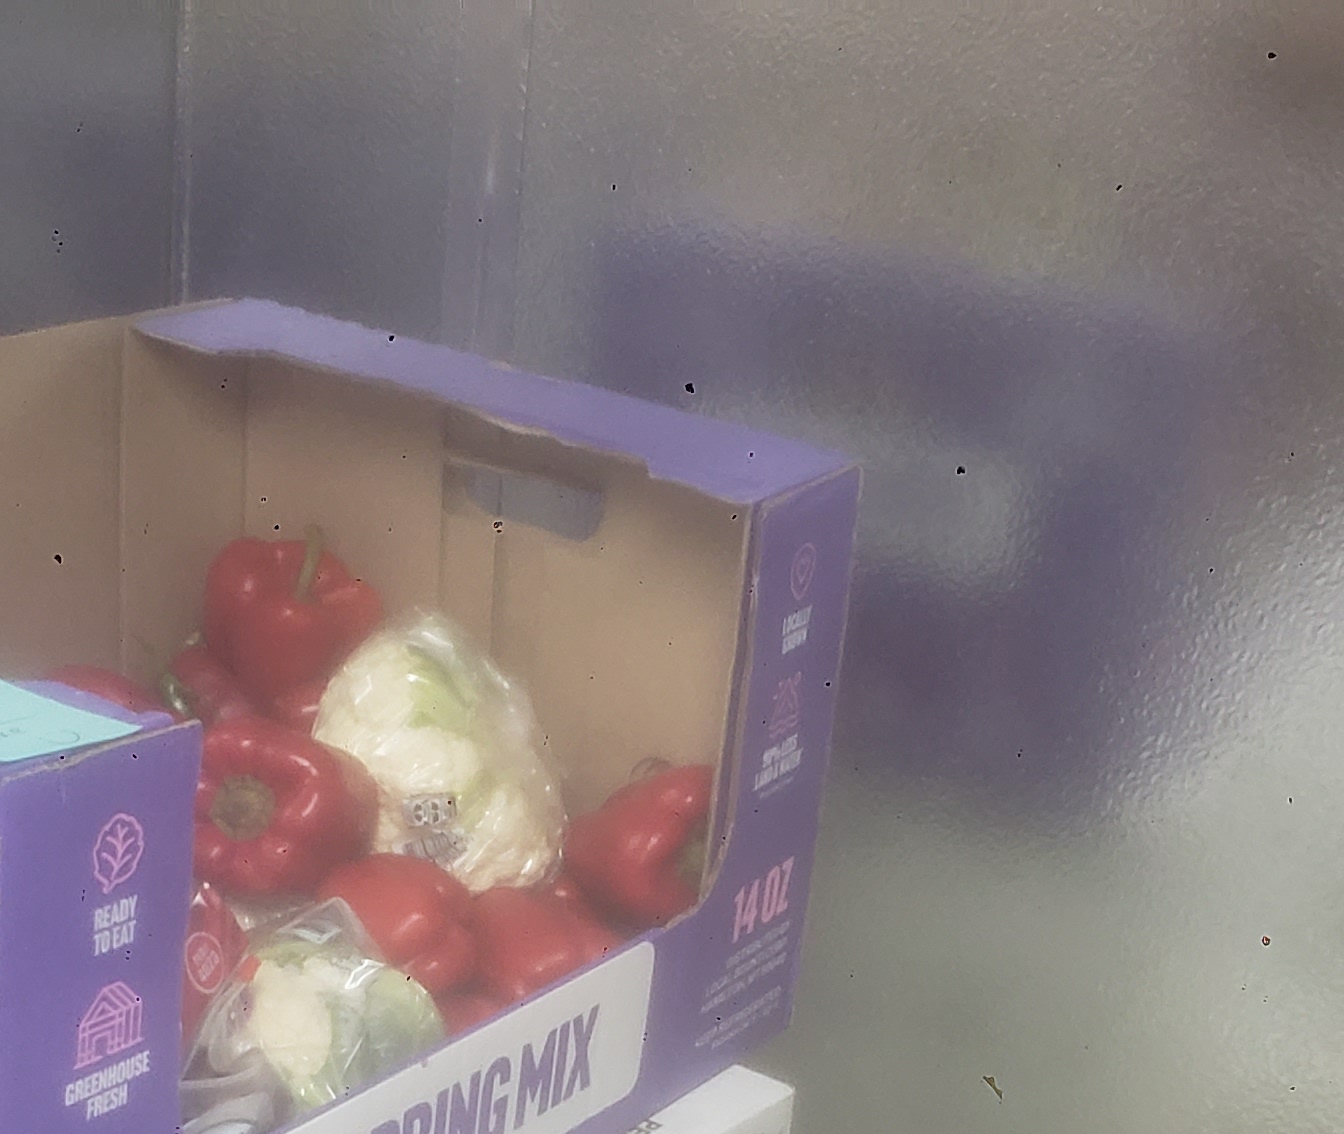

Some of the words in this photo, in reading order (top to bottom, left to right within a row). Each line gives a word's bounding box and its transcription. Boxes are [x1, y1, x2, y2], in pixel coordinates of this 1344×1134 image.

[94, 895, 138, 932] READY
[731, 878, 760, 944] 14
[761, 855, 795, 924] OZ
[93, 930, 111, 957] TO
[112, 920, 137, 949] EAT
[65, 1050, 150, 1107] GREENHOUSE
[513, 1006, 600, 1131] MIX
[86, 1082, 128, 1122] FRESH
